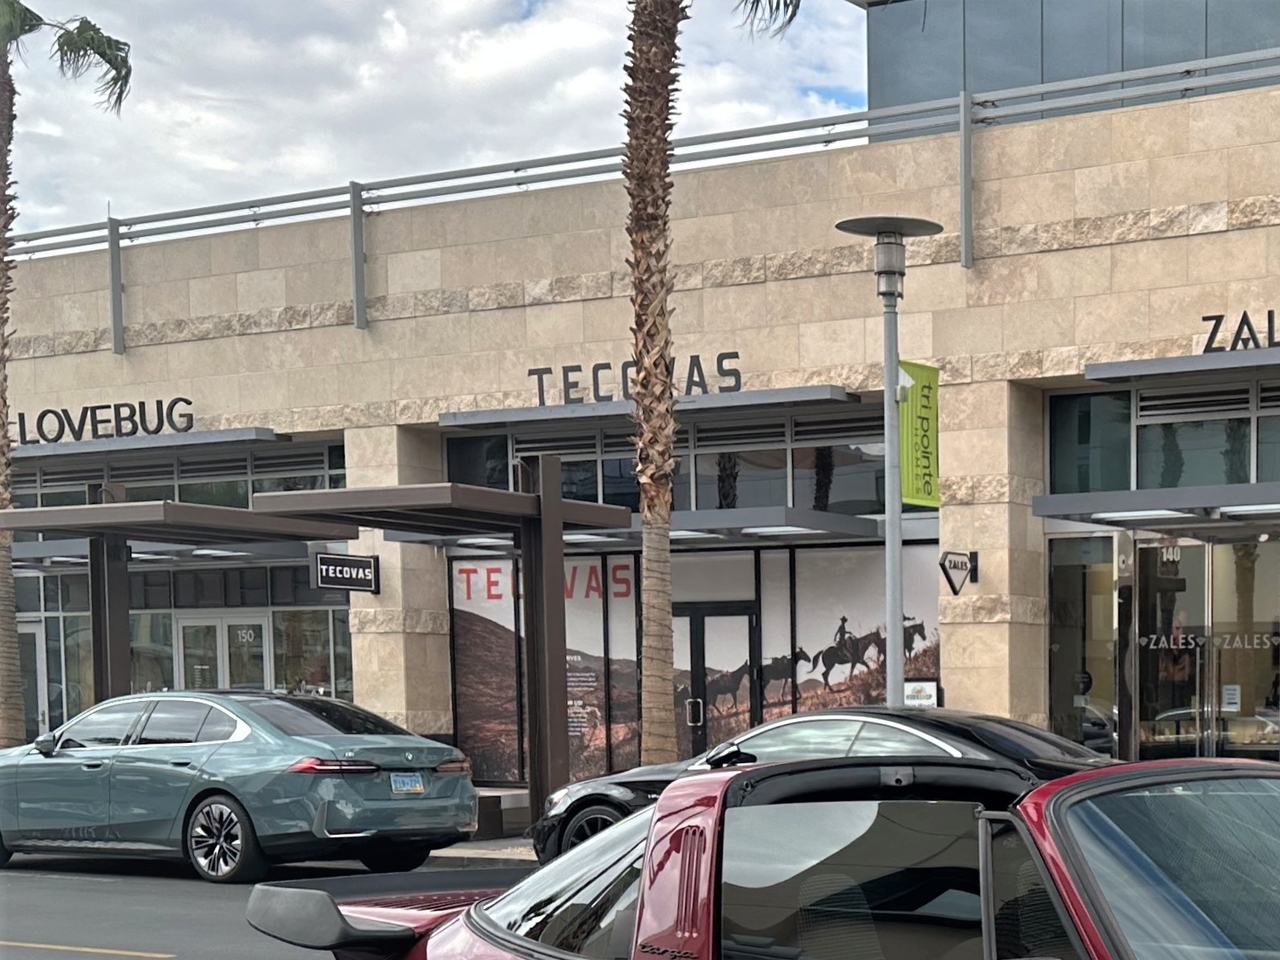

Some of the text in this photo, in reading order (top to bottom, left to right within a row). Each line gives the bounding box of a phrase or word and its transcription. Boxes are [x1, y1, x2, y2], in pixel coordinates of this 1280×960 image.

[18, 397, 194, 445] LOVEBUG
[917, 382, 934, 496] tri pointe
[1161, 547, 1181, 561] 140
[320, 565, 372, 580] TECOVAS
[948, 560, 968, 571] ZALES
[237, 630, 254, 642] 150
[1149, 634, 1195, 649] ZALES
[1222, 634, 1270, 649] ZALES
